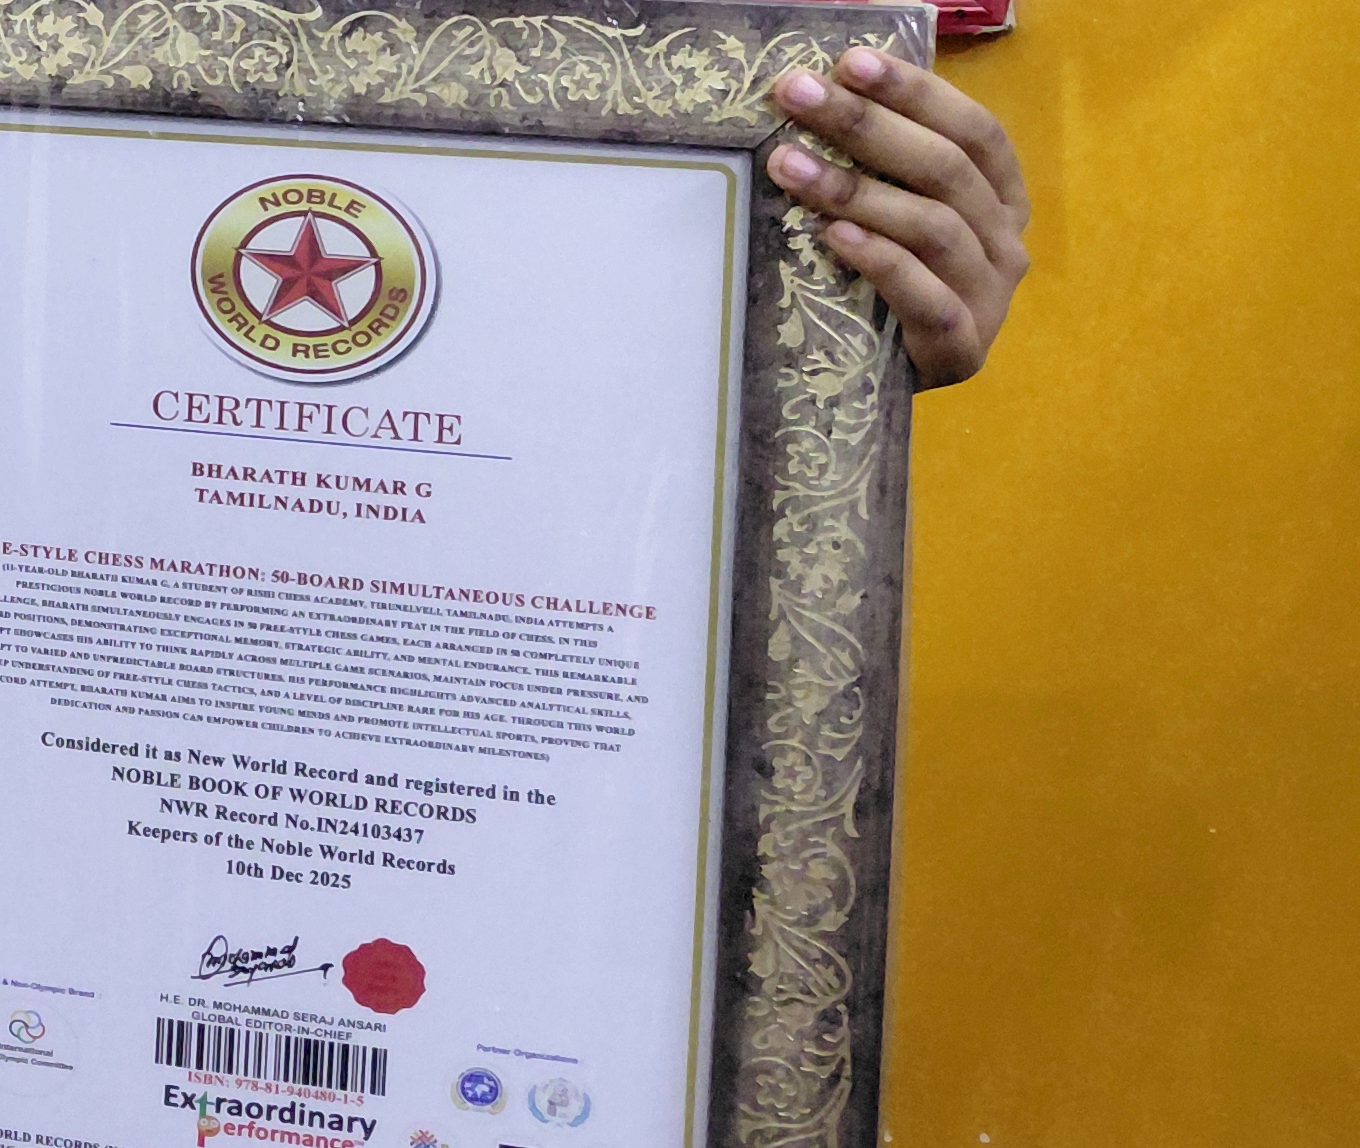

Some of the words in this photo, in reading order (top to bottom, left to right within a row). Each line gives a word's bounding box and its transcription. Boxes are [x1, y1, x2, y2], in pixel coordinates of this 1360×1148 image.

[258, 188, 367, 219] NOBLE
[207, 273, 280, 351] WORLD
[291, 286, 409, 359] RECORDS
[152, 390, 462, 446] CERTIFICATE
[190, 461, 308, 488] BHARATH
[314, 473, 408, 497] KUMAR
[414, 483, 433, 499] G
[193, 488, 348, 520] TAMILNADU,
[353, 503, 427, 525] INDIA
[83, 551, 145, 570] CHESS
[149, 557, 267, 583] MARATHON:
[270, 570, 365, 592] 50-BOARD
[369, 580, 526, 608] SIMULTANEOUS
[530, 596, 658, 621] CHALLENGE
[40, 732, 140, 758] Considered
[144, 744, 159, 760] it
[163, 750, 182, 763] as
[186, 749, 227, 768] New
[231, 753, 288, 776] World
[293, 761, 359, 784] Record
[364, 773, 399, 789] and
[404, 777, 497, 800] registered
[502, 785, 521, 803] in
[526, 789, 557, 807] the
[110, 766, 182, 790] NOBLE
[186, 775, 250, 798] BOOK
[253, 784, 284, 801] OF
[288, 787, 369, 812] WORLD
[373, 797, 477, 825] RECORDS
[158, 797, 210, 819] NWR
[214, 804, 279, 828] Record
[284, 813, 425, 845] No.IN24103437
[126, 820, 199, 844] Keepers
[203, 832, 224, 847] of
[226, 834, 256, 851] the
[259, 837, 314, 859] Noble
[318, 844, 375, 866] World
[380, 852, 456, 876] Records
[225, 859, 265, 879] 10th
[269, 865, 304, 884] Dec
[308, 870, 352, 890] 2025
[191, 1011, 242, 1027] GLOBAL
[244, 1019, 353, 1042] EDITOR-IN-CHIEF
[212, 1001, 290, 1020] MOHAMMAD
[292, 1012, 335, 1027] SERAJ
[337, 1018, 387, 1033] ANSARI
[164, 1084, 377, 1140] Extraordinary
[187, 1071, 230, 1089] ISBN:
[234, 1078, 365, 1108] 978-81-940480-1-5
